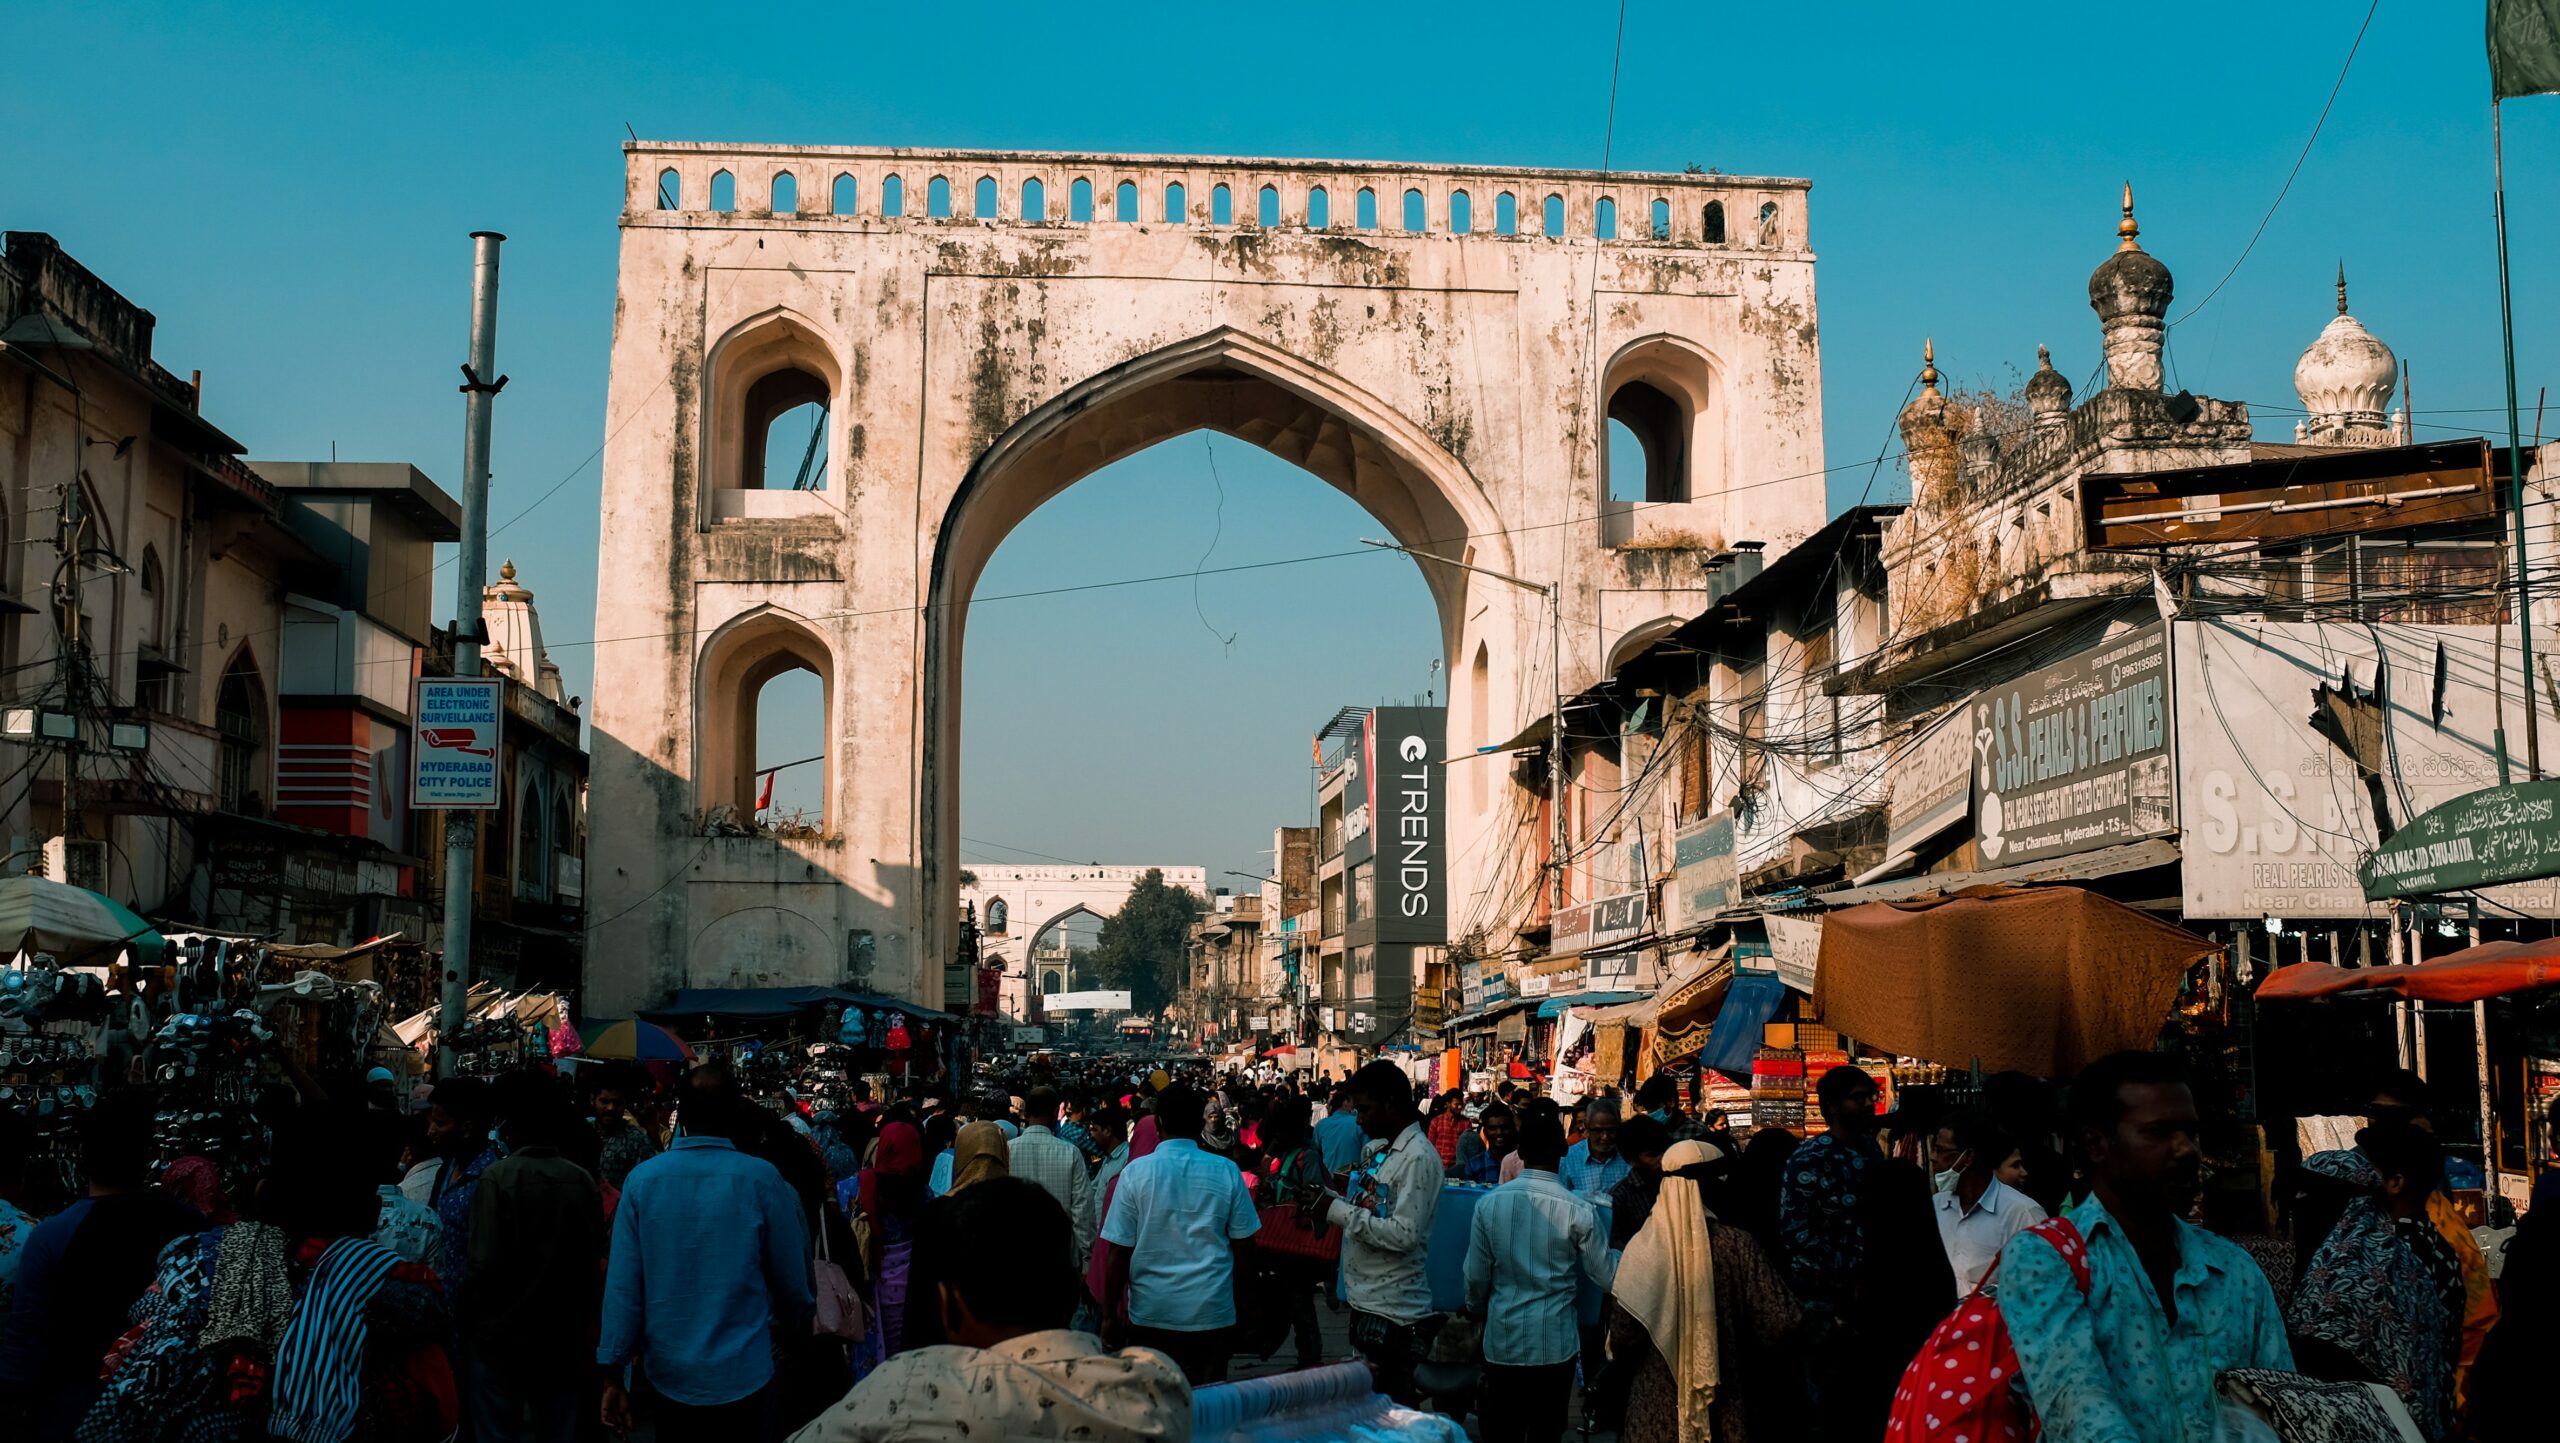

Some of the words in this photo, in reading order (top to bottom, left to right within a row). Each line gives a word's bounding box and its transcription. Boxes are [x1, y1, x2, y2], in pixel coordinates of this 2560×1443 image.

[2121, 652, 2163, 678] 9963195885
[427, 687, 454, 698] AREA
[456, 687, 491, 698] UNDER
[427, 699, 490, 710] ELECTRONIC
[420, 712, 496, 723] SURVEILLANCE
[2029, 707, 2075, 784] PEARLS
[2078, 703, 2088, 770] &
[2091, 675, 2163, 766] PERFUMES
[420, 762, 493, 773] HYDERABAD
[2402, 755, 2420, 777] &
[418, 776, 447, 788] CITY
[449, 777, 492, 788] POLICE
[1925, 790, 1942, 810] Book
[2004, 800, 2016, 832] REAL
[2016, 795, 2033, 829] PEARLS
[2034, 792, 2045, 825] SETS
[2073, 780, 2093, 816] TESTED
[2093, 769, 2127, 812] CERTIFICATE
[2202, 770, 2318, 854] S.S.
[1401, 764, 1428, 917] TRENDS
[2009, 840, 2025, 854] Near
[2026, 833, 2063, 847] Charminar,
[2064, 820, 2104, 845] Hyderabad
[2394, 846, 2429, 874] MASJID
[2428, 837, 2475, 868] SHUJAIYA
[2253, 863, 2287, 888] REAL
[2290, 863, 2341, 888] PEARLS
[2243, 893, 2298, 910] Near
